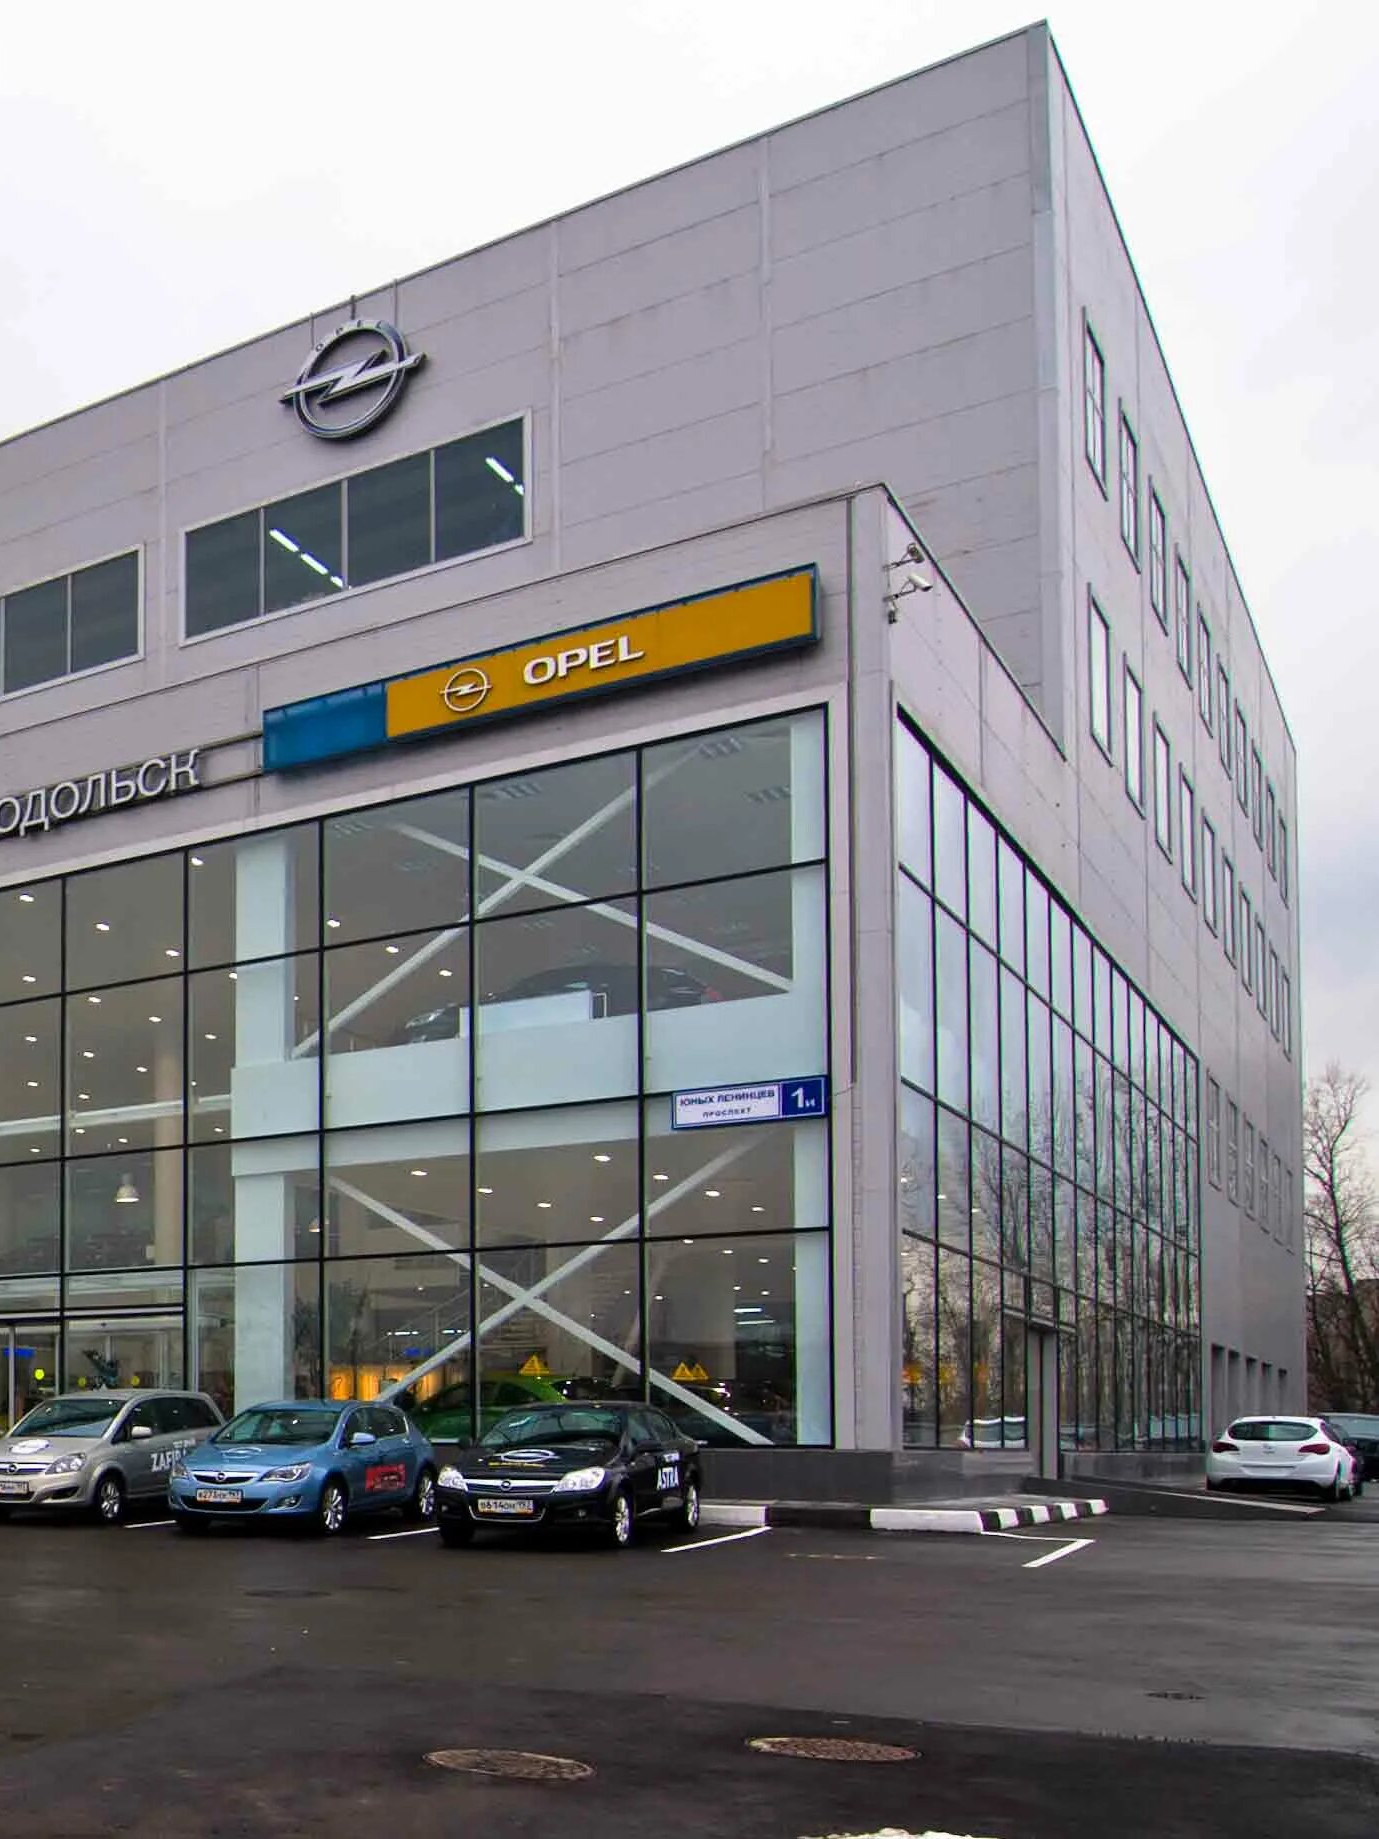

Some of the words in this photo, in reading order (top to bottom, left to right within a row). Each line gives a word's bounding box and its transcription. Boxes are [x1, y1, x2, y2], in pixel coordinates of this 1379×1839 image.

[523, 635, 645, 685] OPEL
[680, 1095, 714, 1106] ЮНЫХ
[717, 1089, 775, 1104] ЛЕНИНЦЕВ
[702, 1106, 752, 1118] ПРОСПЕКТ
[656, 1465, 679, 1490] ASTRA
